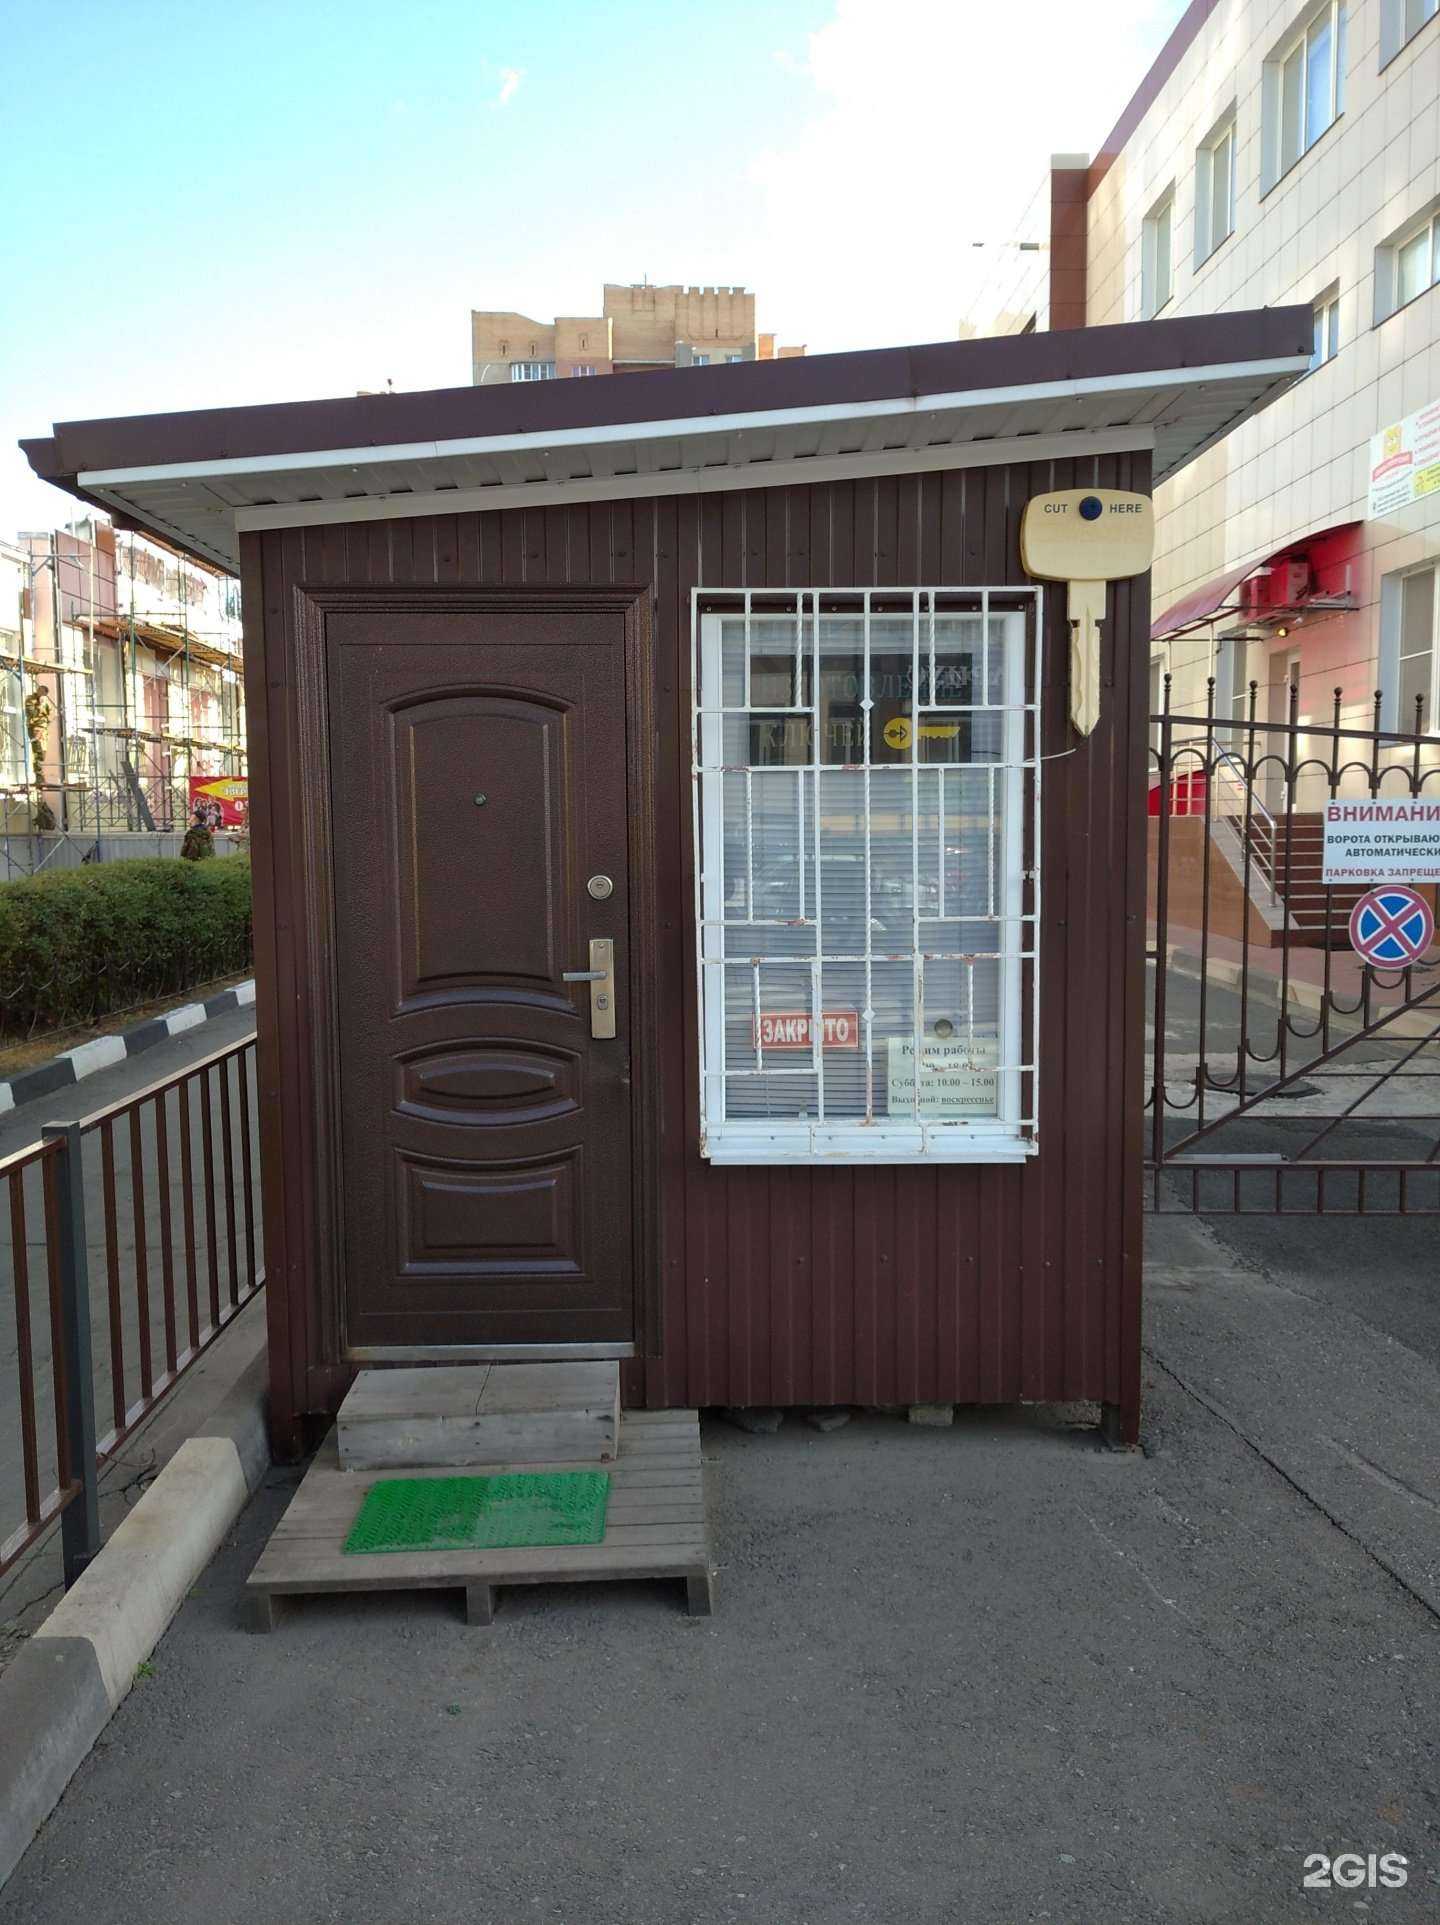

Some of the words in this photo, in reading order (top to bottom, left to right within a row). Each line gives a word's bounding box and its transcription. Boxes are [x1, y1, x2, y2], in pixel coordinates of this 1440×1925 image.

[1043, 503, 1069, 514] CUT
[1109, 503, 1143, 514] HERE
[1327, 805, 1440, 822] ВНИМАНИ
[1326, 835, 1371, 844] ВОРОТА
[1326, 868, 1385, 877] ПАРКОВКА
[902, 1045, 940, 1056] Реим
[891, 1078, 934, 1089] Суббта:
[937, 1078, 961, 1087] 10.00
[972, 1078, 994, 1087] 15.00
[891, 1096, 939, 1104] Выхной:
